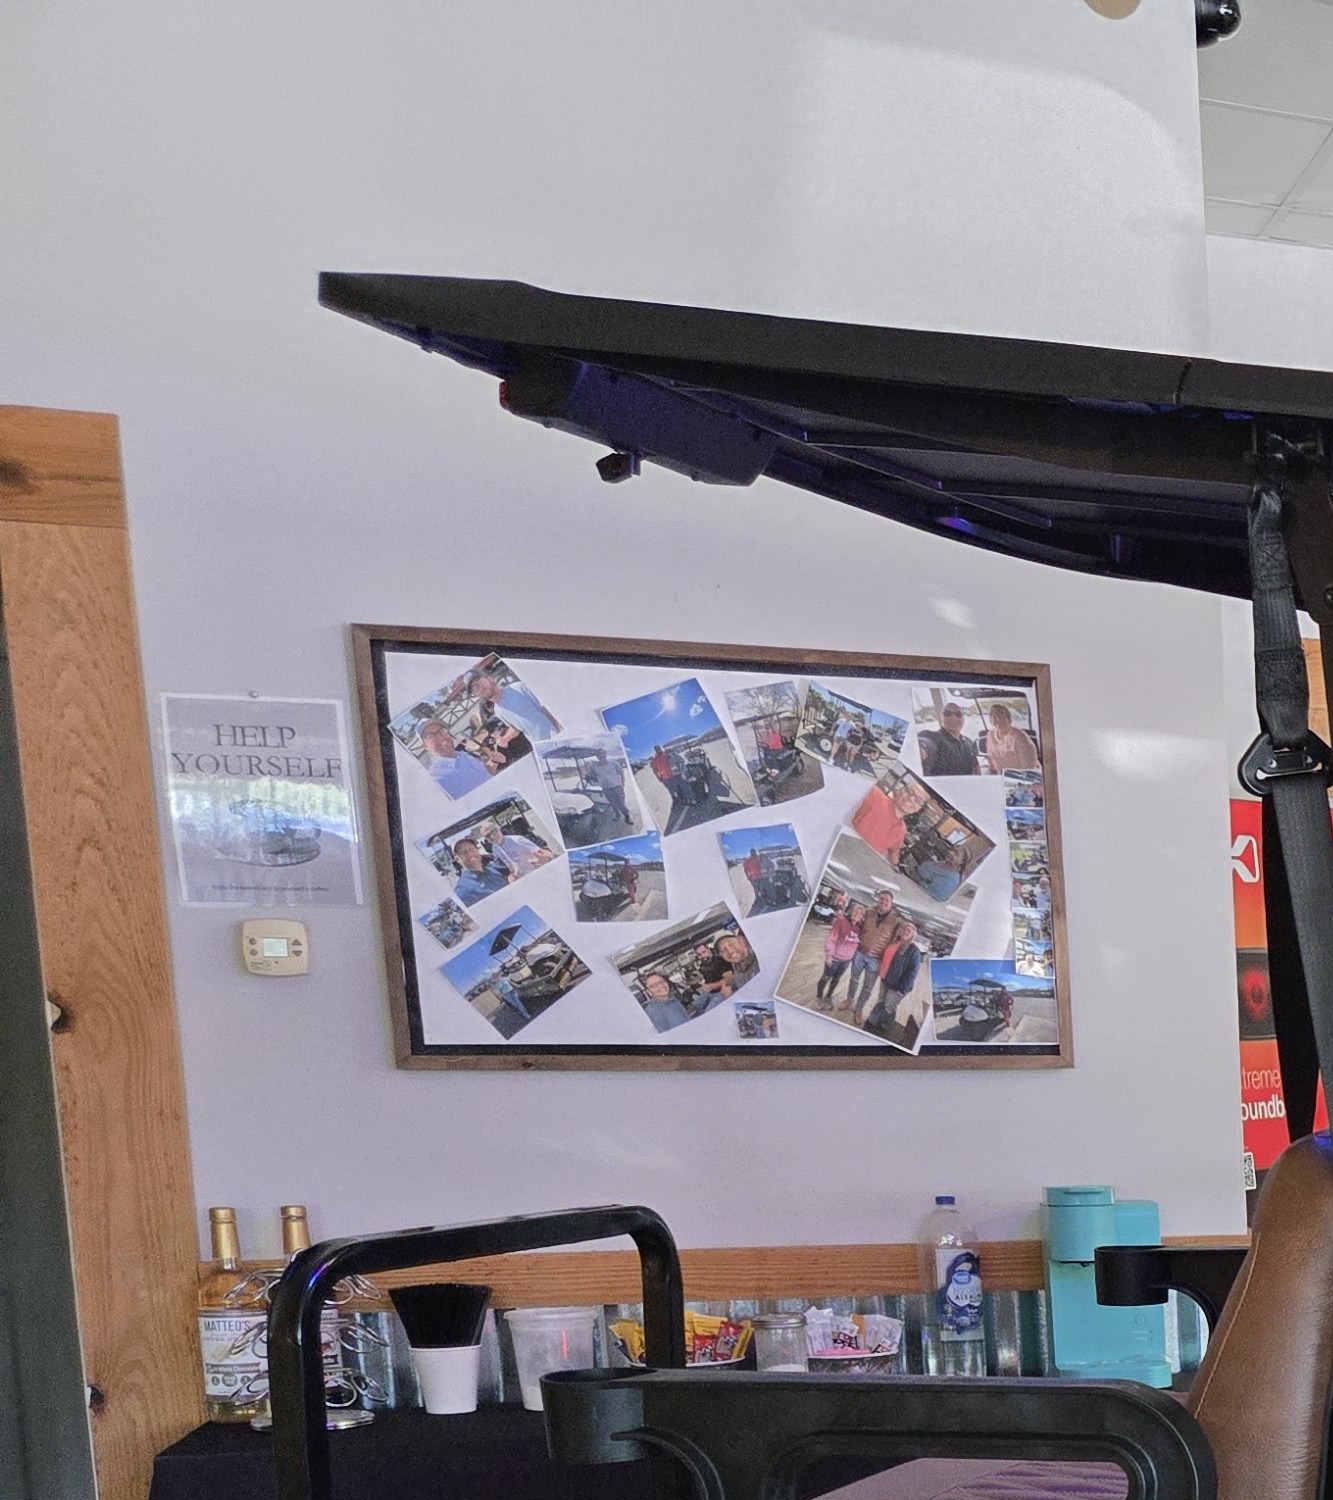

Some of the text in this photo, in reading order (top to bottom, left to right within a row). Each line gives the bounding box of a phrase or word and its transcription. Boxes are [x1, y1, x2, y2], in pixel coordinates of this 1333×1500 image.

[213, 723, 297, 749] HELP
[171, 752, 344, 779] YOURSELF
[204, 1320, 251, 1331] MATTEO'S
